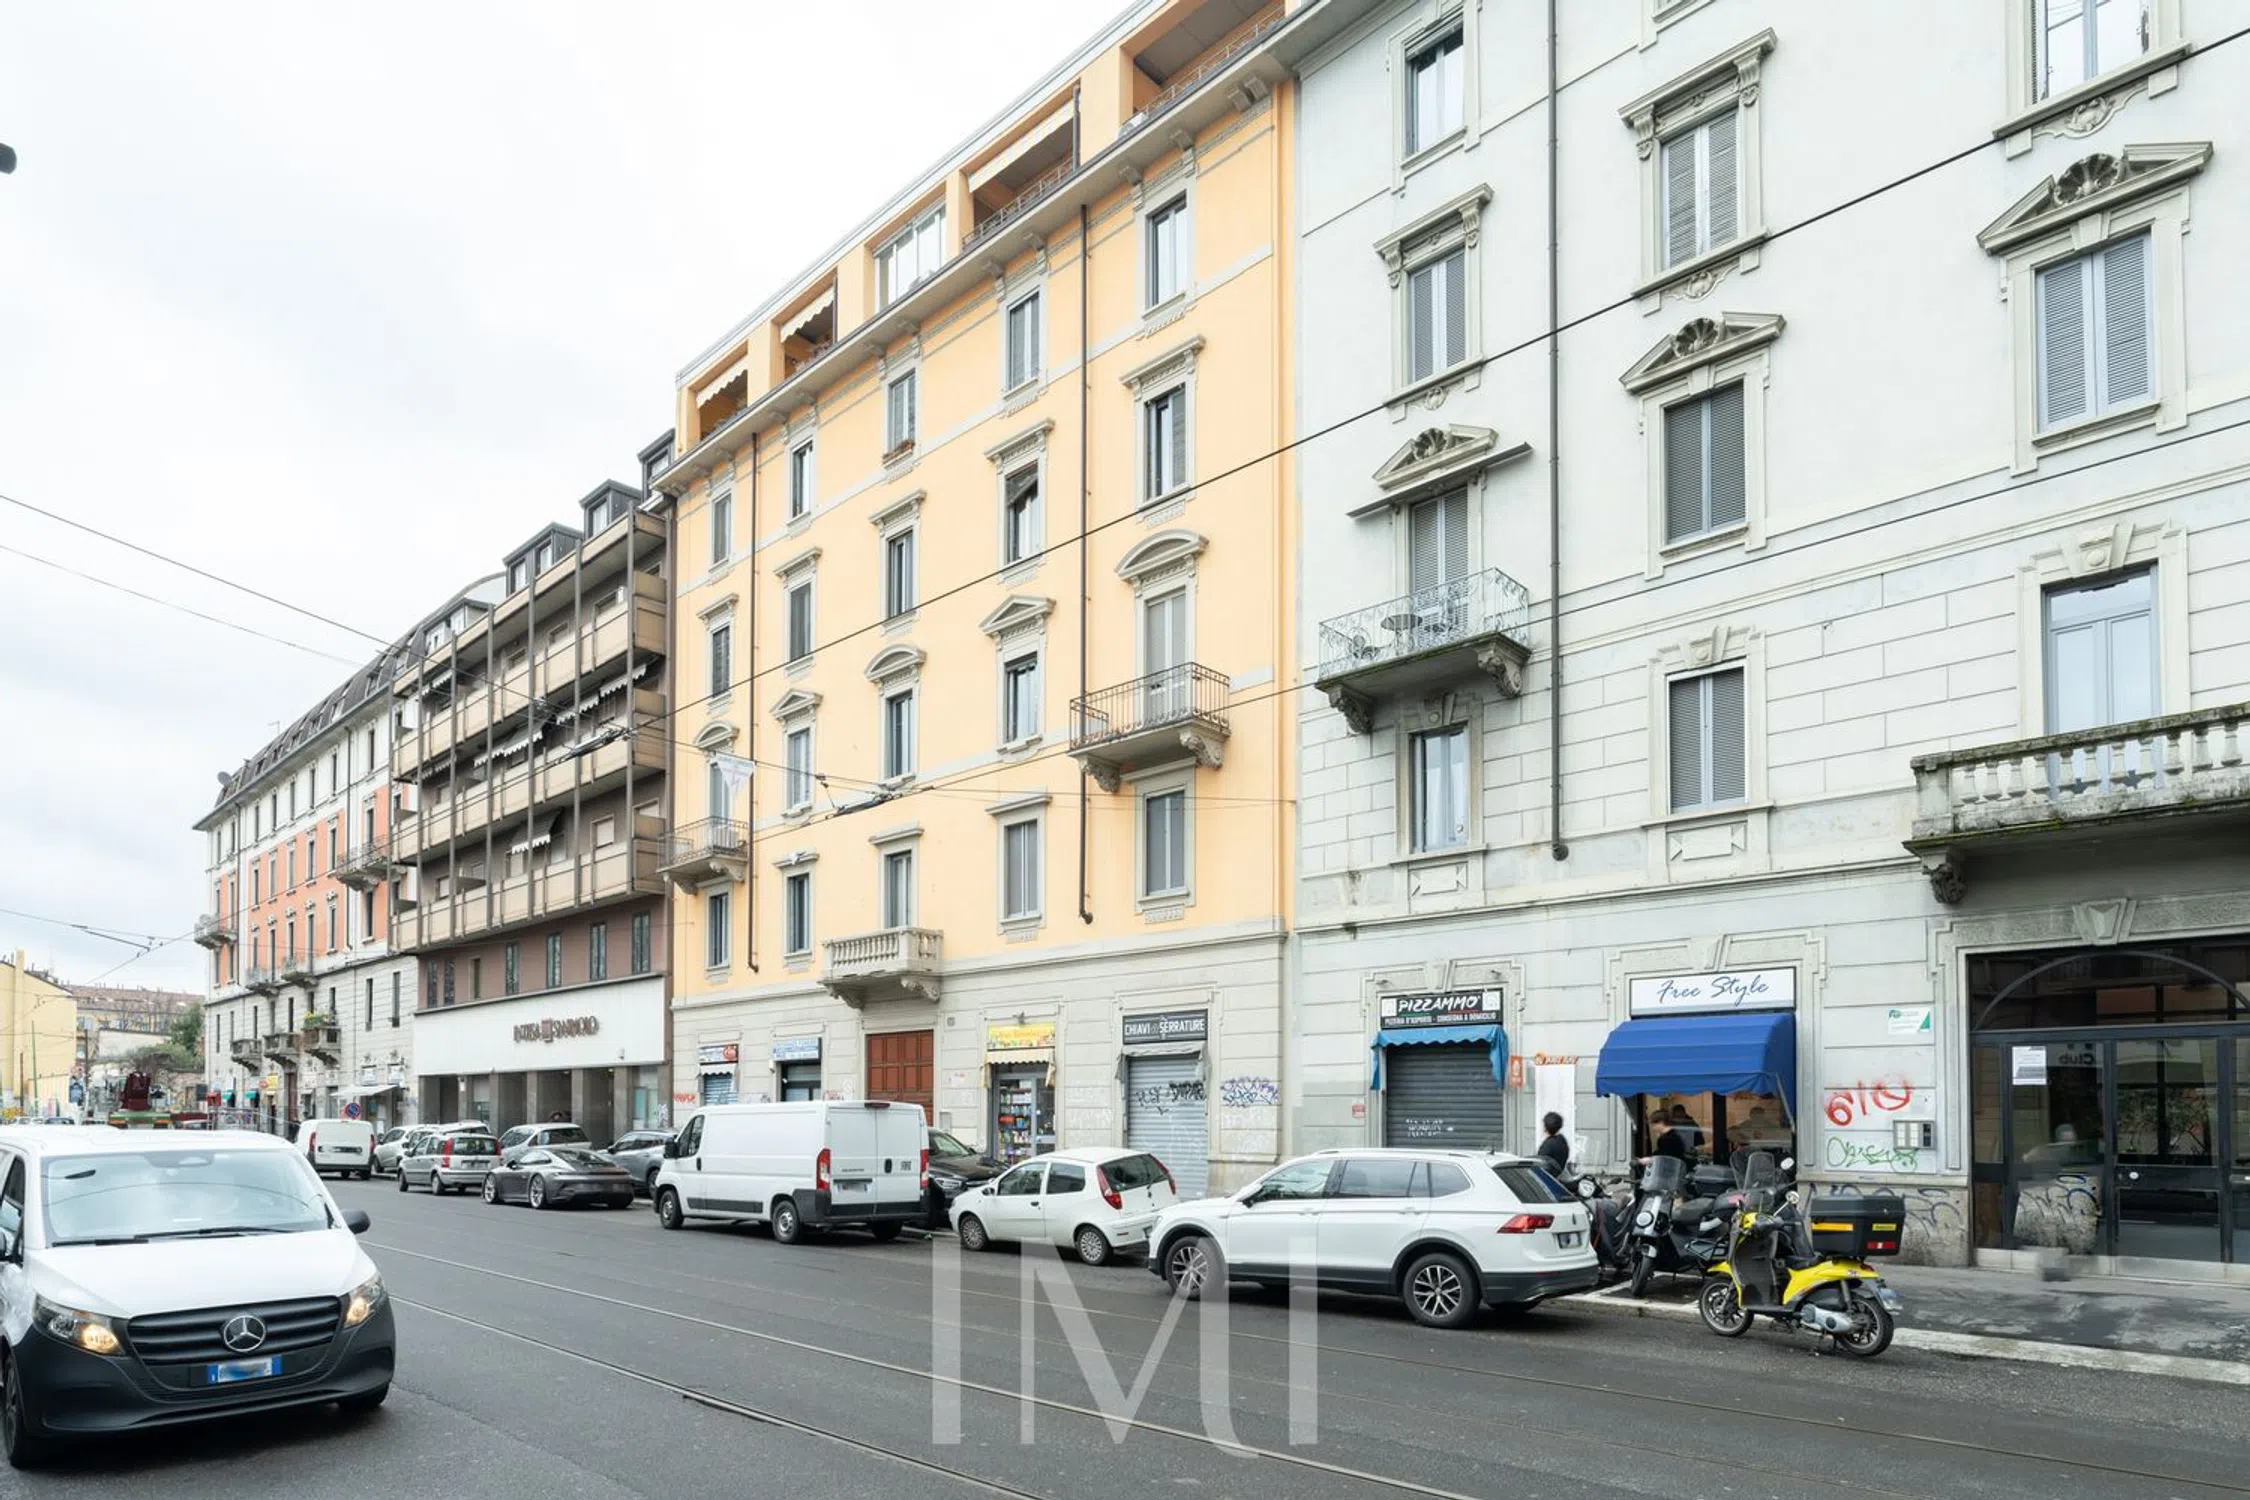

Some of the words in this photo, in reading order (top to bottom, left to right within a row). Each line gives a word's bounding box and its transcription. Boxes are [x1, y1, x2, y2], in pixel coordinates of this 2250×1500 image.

[1656, 979, 1702, 1004] Free
[1711, 974, 1770, 1007] Style
[1124, 1023, 1150, 1036] CHIAVI
[1160, 1018, 1205, 1034] SERRATURE
